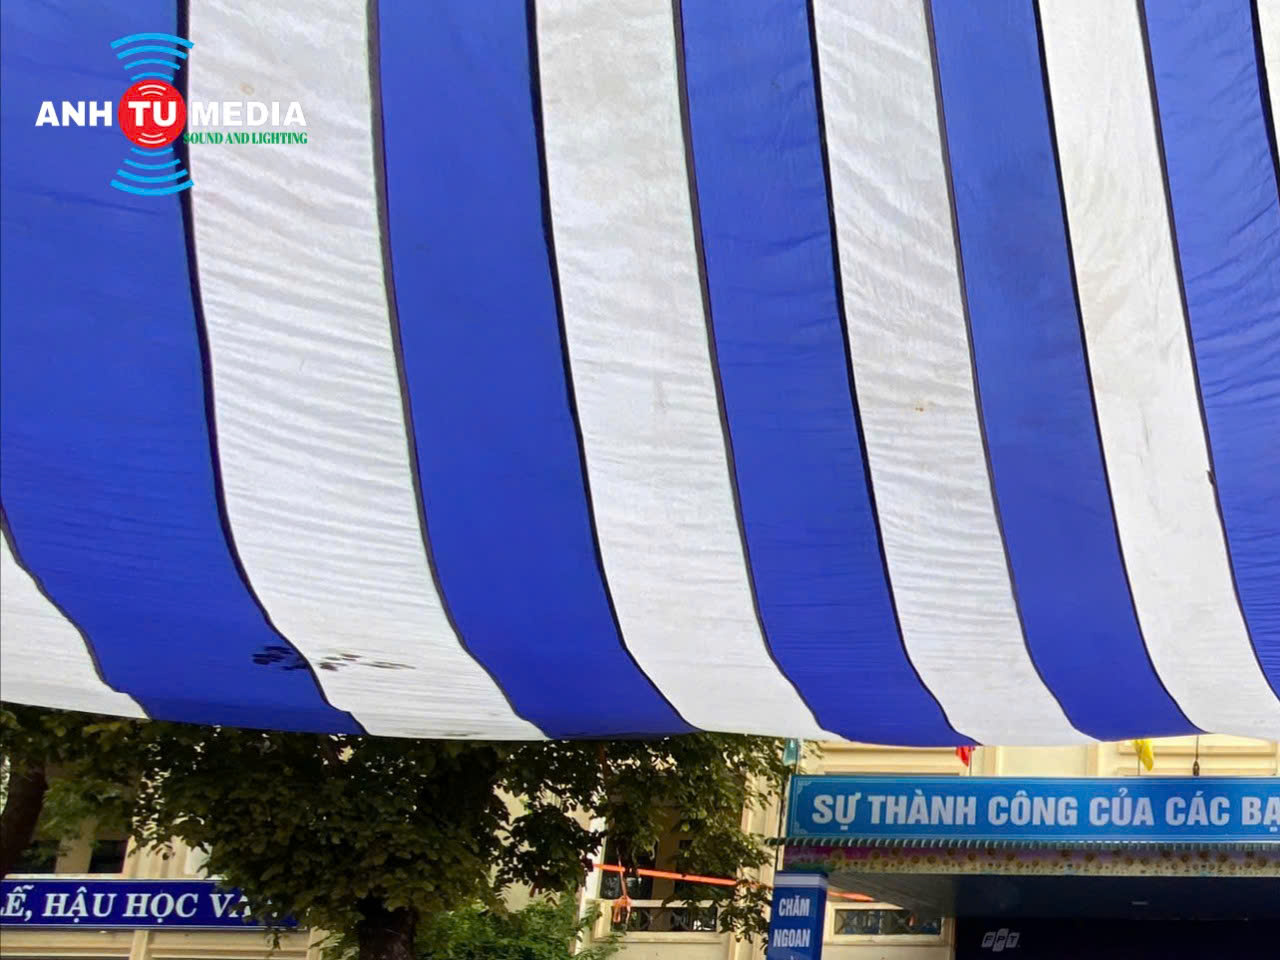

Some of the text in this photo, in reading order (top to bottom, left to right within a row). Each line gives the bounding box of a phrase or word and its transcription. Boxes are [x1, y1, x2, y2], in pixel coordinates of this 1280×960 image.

[812, 792, 861, 830] SỰ
[868, 789, 976, 825] THÀNH
[988, 790, 1078, 826] CÔNG
[1089, 788, 1154, 826] CỦA
[1165, 791, 1230, 827] CÁC
[42, 887, 117, 923] HẬU
[122, 892, 199, 923] HỌC
[779, 896, 809, 916] CHĂM
[773, 929, 810, 947] NGOAN
